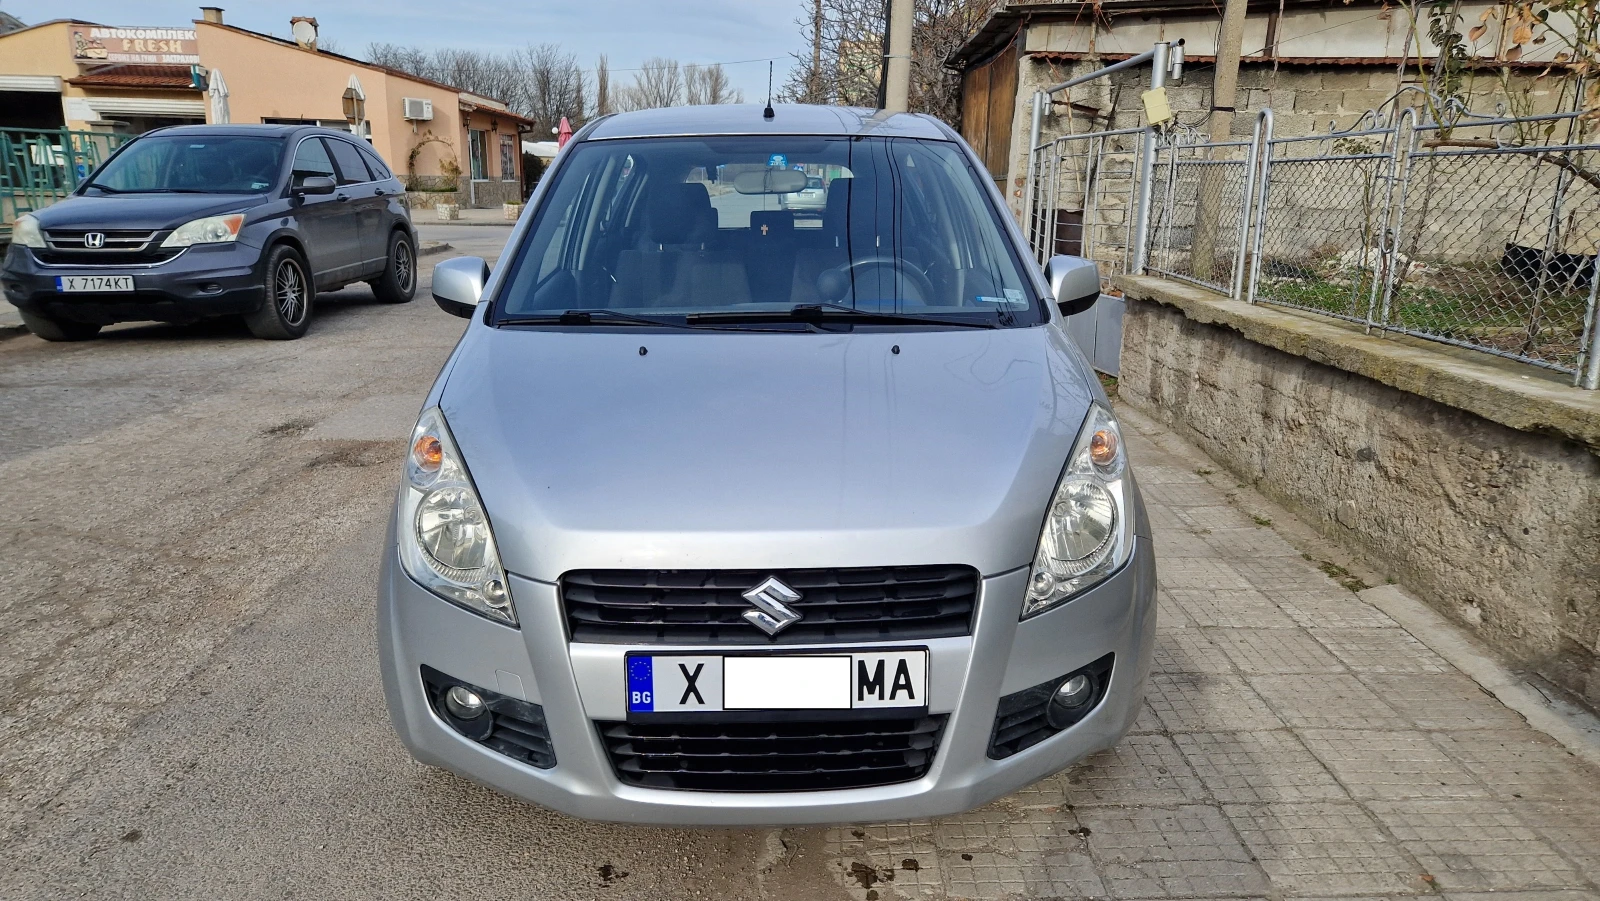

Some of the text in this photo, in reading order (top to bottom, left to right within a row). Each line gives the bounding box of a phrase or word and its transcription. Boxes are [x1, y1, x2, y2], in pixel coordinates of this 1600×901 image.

[122, 39, 182, 53] FRESH
[81, 277, 130, 290] 7174KT
[632, 658, 915, 705] BG X MA
